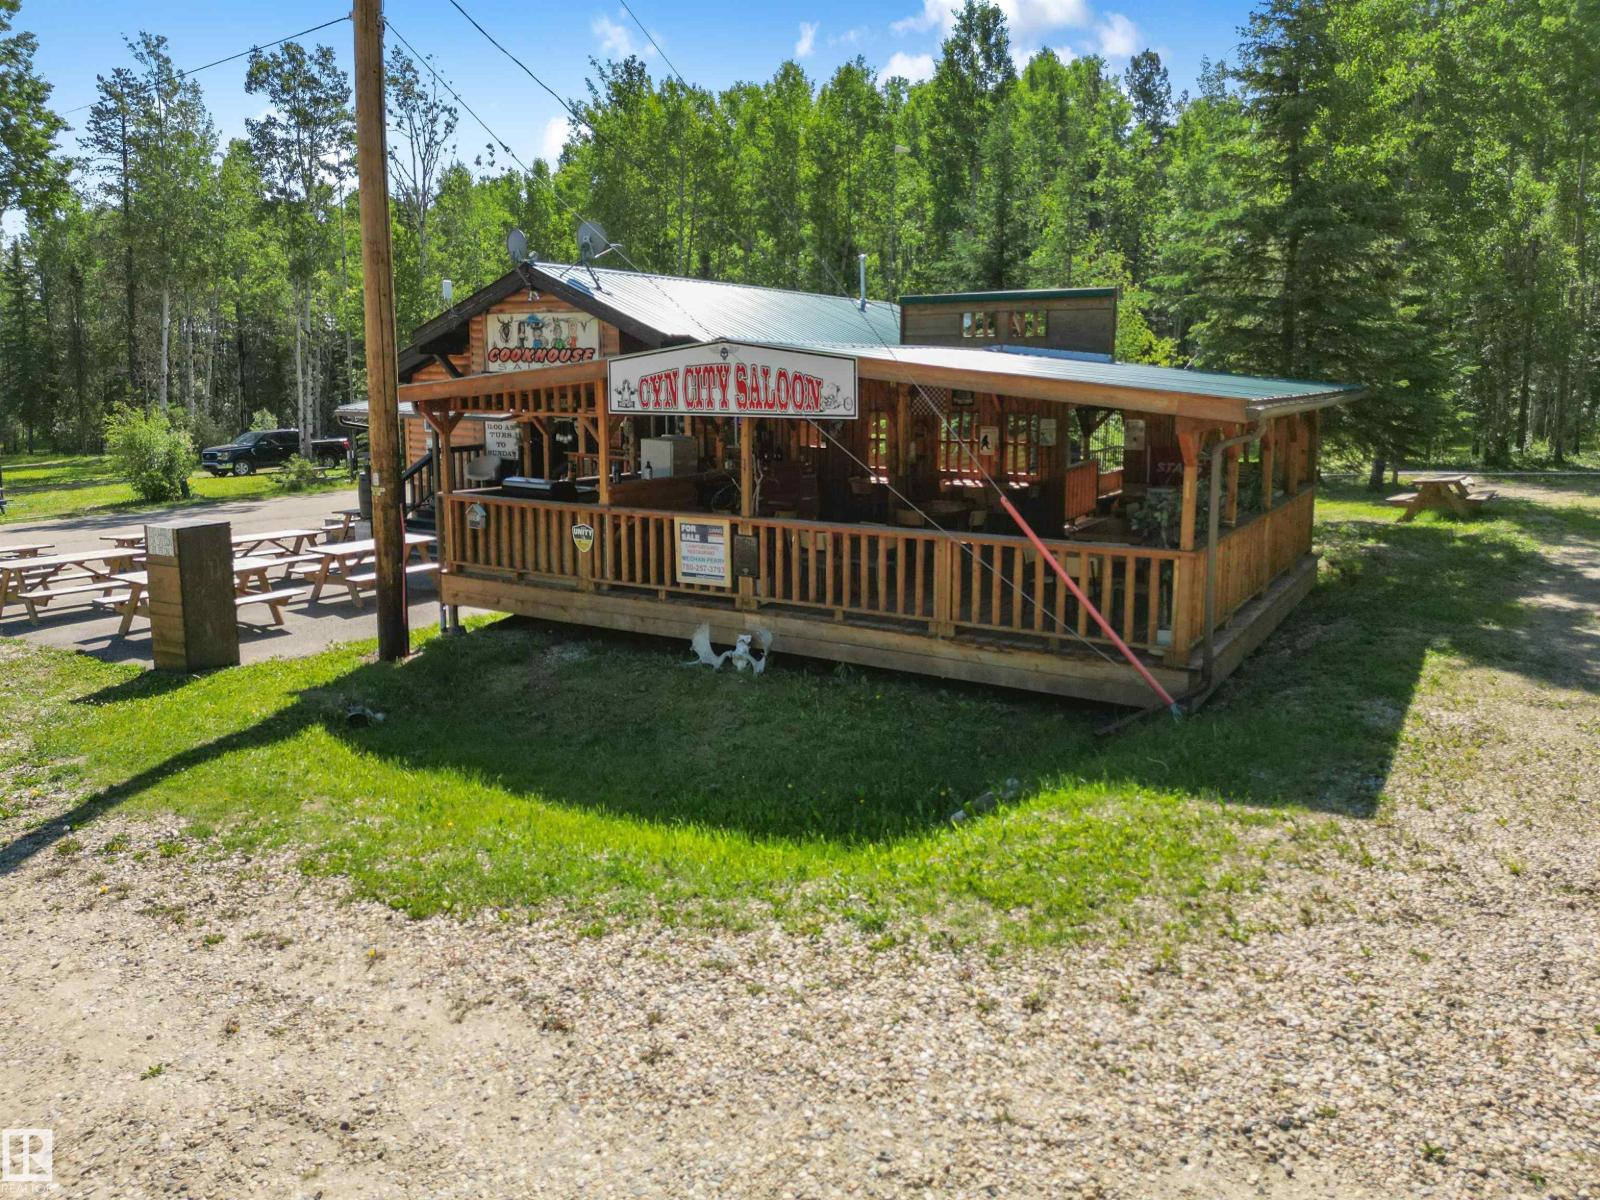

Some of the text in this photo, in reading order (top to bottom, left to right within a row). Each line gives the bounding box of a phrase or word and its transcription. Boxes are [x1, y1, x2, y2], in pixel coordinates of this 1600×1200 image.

[488, 347, 596, 363] COOKHOUSE
[638, 362, 824, 412] CYN CITY SALOON
[573, 527, 593, 536] UNITY
[681, 524, 697, 532] FOR
[681, 533, 700, 542] SALE
